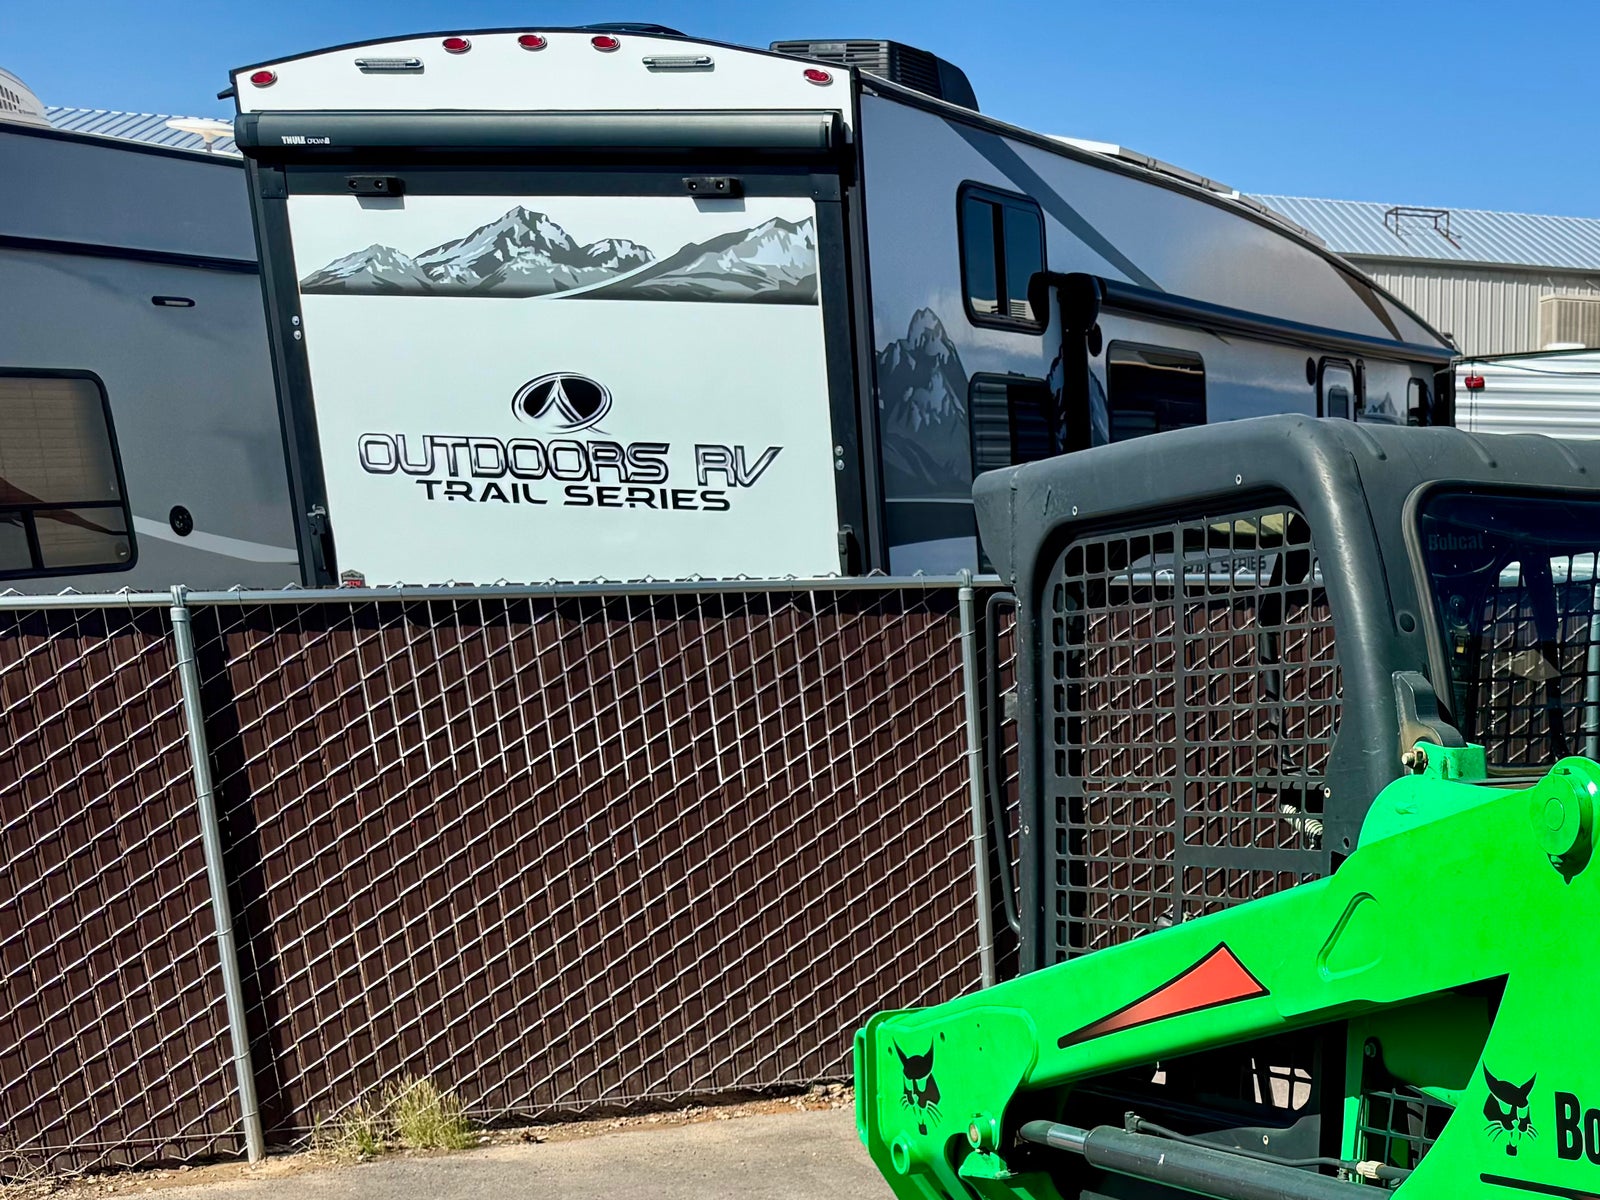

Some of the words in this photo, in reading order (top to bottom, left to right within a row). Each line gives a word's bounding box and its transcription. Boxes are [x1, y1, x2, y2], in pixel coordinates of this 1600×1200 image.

[358, 433, 670, 485] OUTDOORS
[694, 444, 784, 488] RV
[415, 479, 548, 505] TRAIL
[563, 485, 731, 511] SERIES
[1427, 533, 1484, 550] Bobcat
